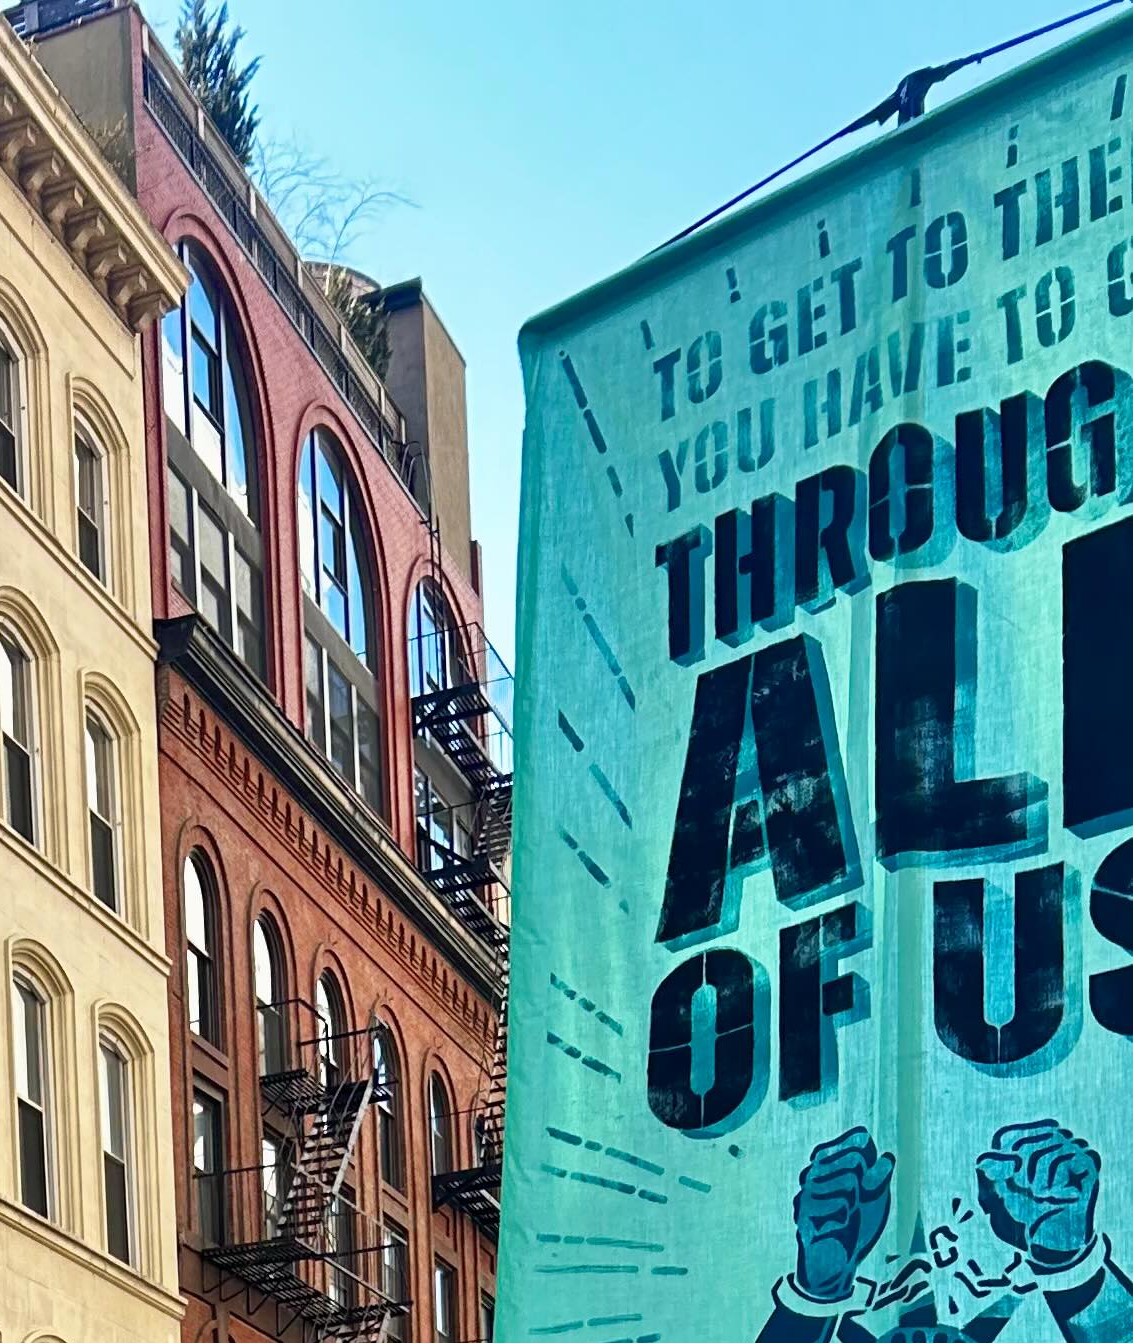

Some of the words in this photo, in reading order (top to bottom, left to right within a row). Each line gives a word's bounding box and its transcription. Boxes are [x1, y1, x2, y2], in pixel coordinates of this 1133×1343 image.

[653, 330, 724, 422] TO
[748, 259, 863, 375] GET
[886, 210, 968, 303] TO
[994, 136, 1133, 261] THE
[658, 398, 778, 513] YOU
[803, 310, 972, 450] HAVE
[997, 265, 1075, 366] TO
[647, 900, 875, 1139] OF
